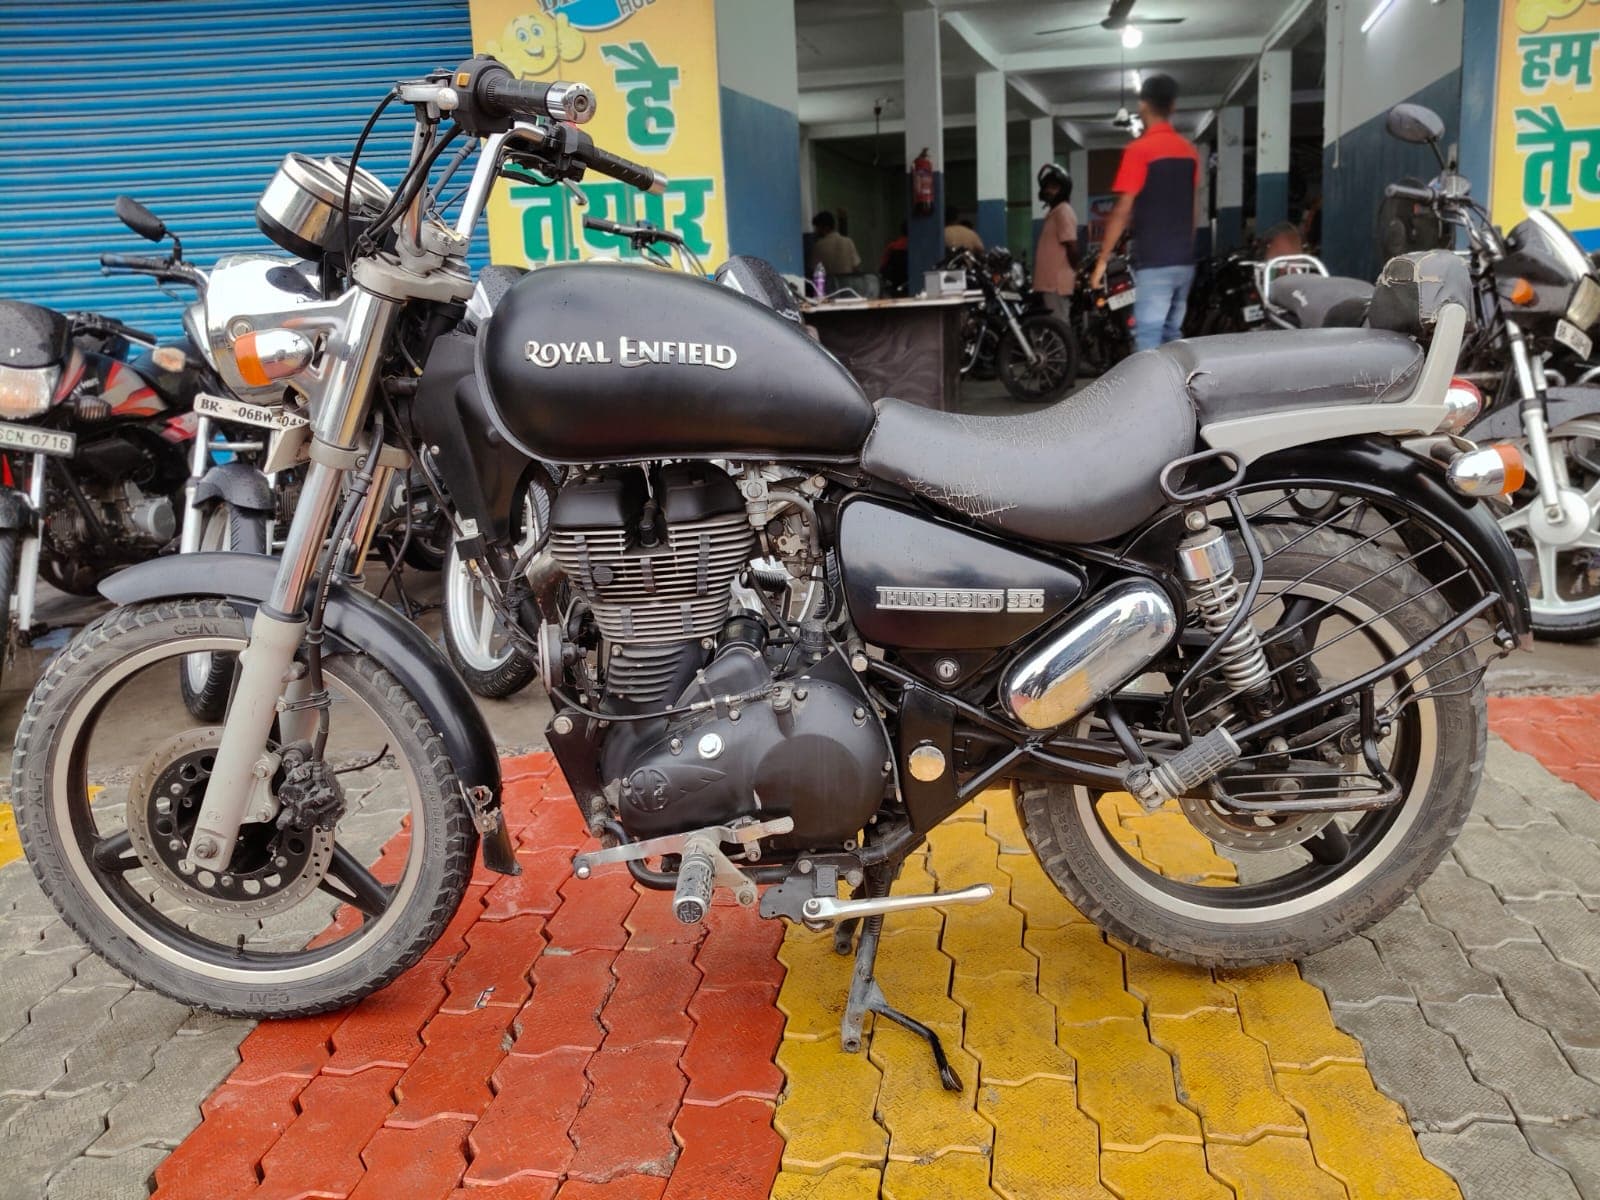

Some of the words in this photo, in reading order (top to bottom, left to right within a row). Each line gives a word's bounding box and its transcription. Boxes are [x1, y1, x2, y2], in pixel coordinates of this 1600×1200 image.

[1517, 32, 1600, 89] हम
[600, 40, 679, 149] है
[524, 340, 613, 368] ROYAL
[619, 336, 738, 370] ENFIELD
[31, 433, 69, 450] 0716
[1007, 588, 1045, 613] 350
